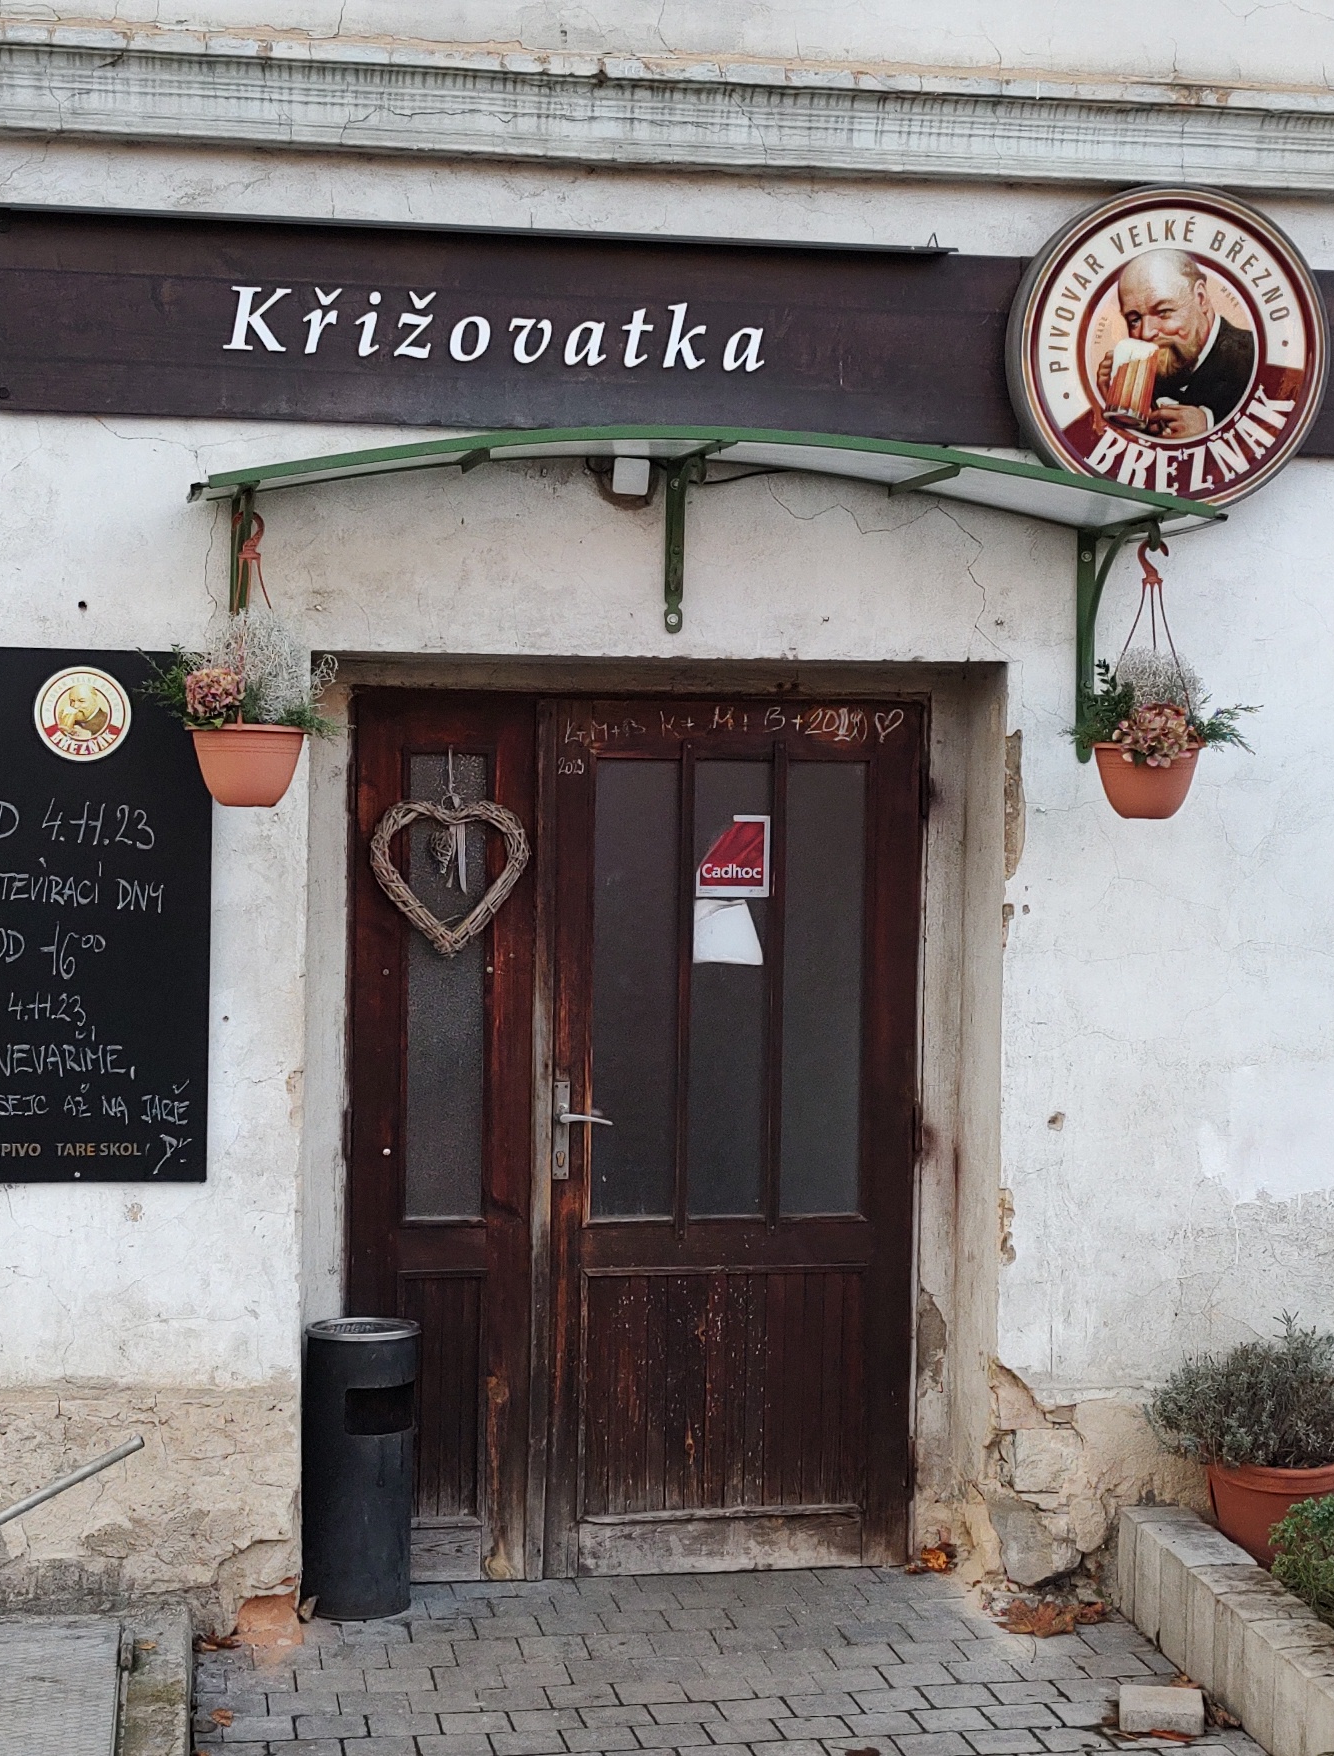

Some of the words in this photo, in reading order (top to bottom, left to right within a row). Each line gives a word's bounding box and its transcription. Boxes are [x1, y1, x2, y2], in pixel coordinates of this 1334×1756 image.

[1048, 253, 1104, 373] PIVOVAR
[1110, 216, 1196, 255] VELKÉ
[1209, 230, 1290, 321] BŘEZNO
[223, 285, 765, 372] Křižovatka
[1084, 383, 1296, 496] BŘEZŇÁK
[701, 863, 762, 879] Cadhoc
[116, 878, 165, 914] DNY
[64, 1083, 92, 1117] AŽ
[102, 1095, 128, 1125] NA
[1, 1143, 41, 1157] PIVO
[56, 1143, 96, 1156] TARE
